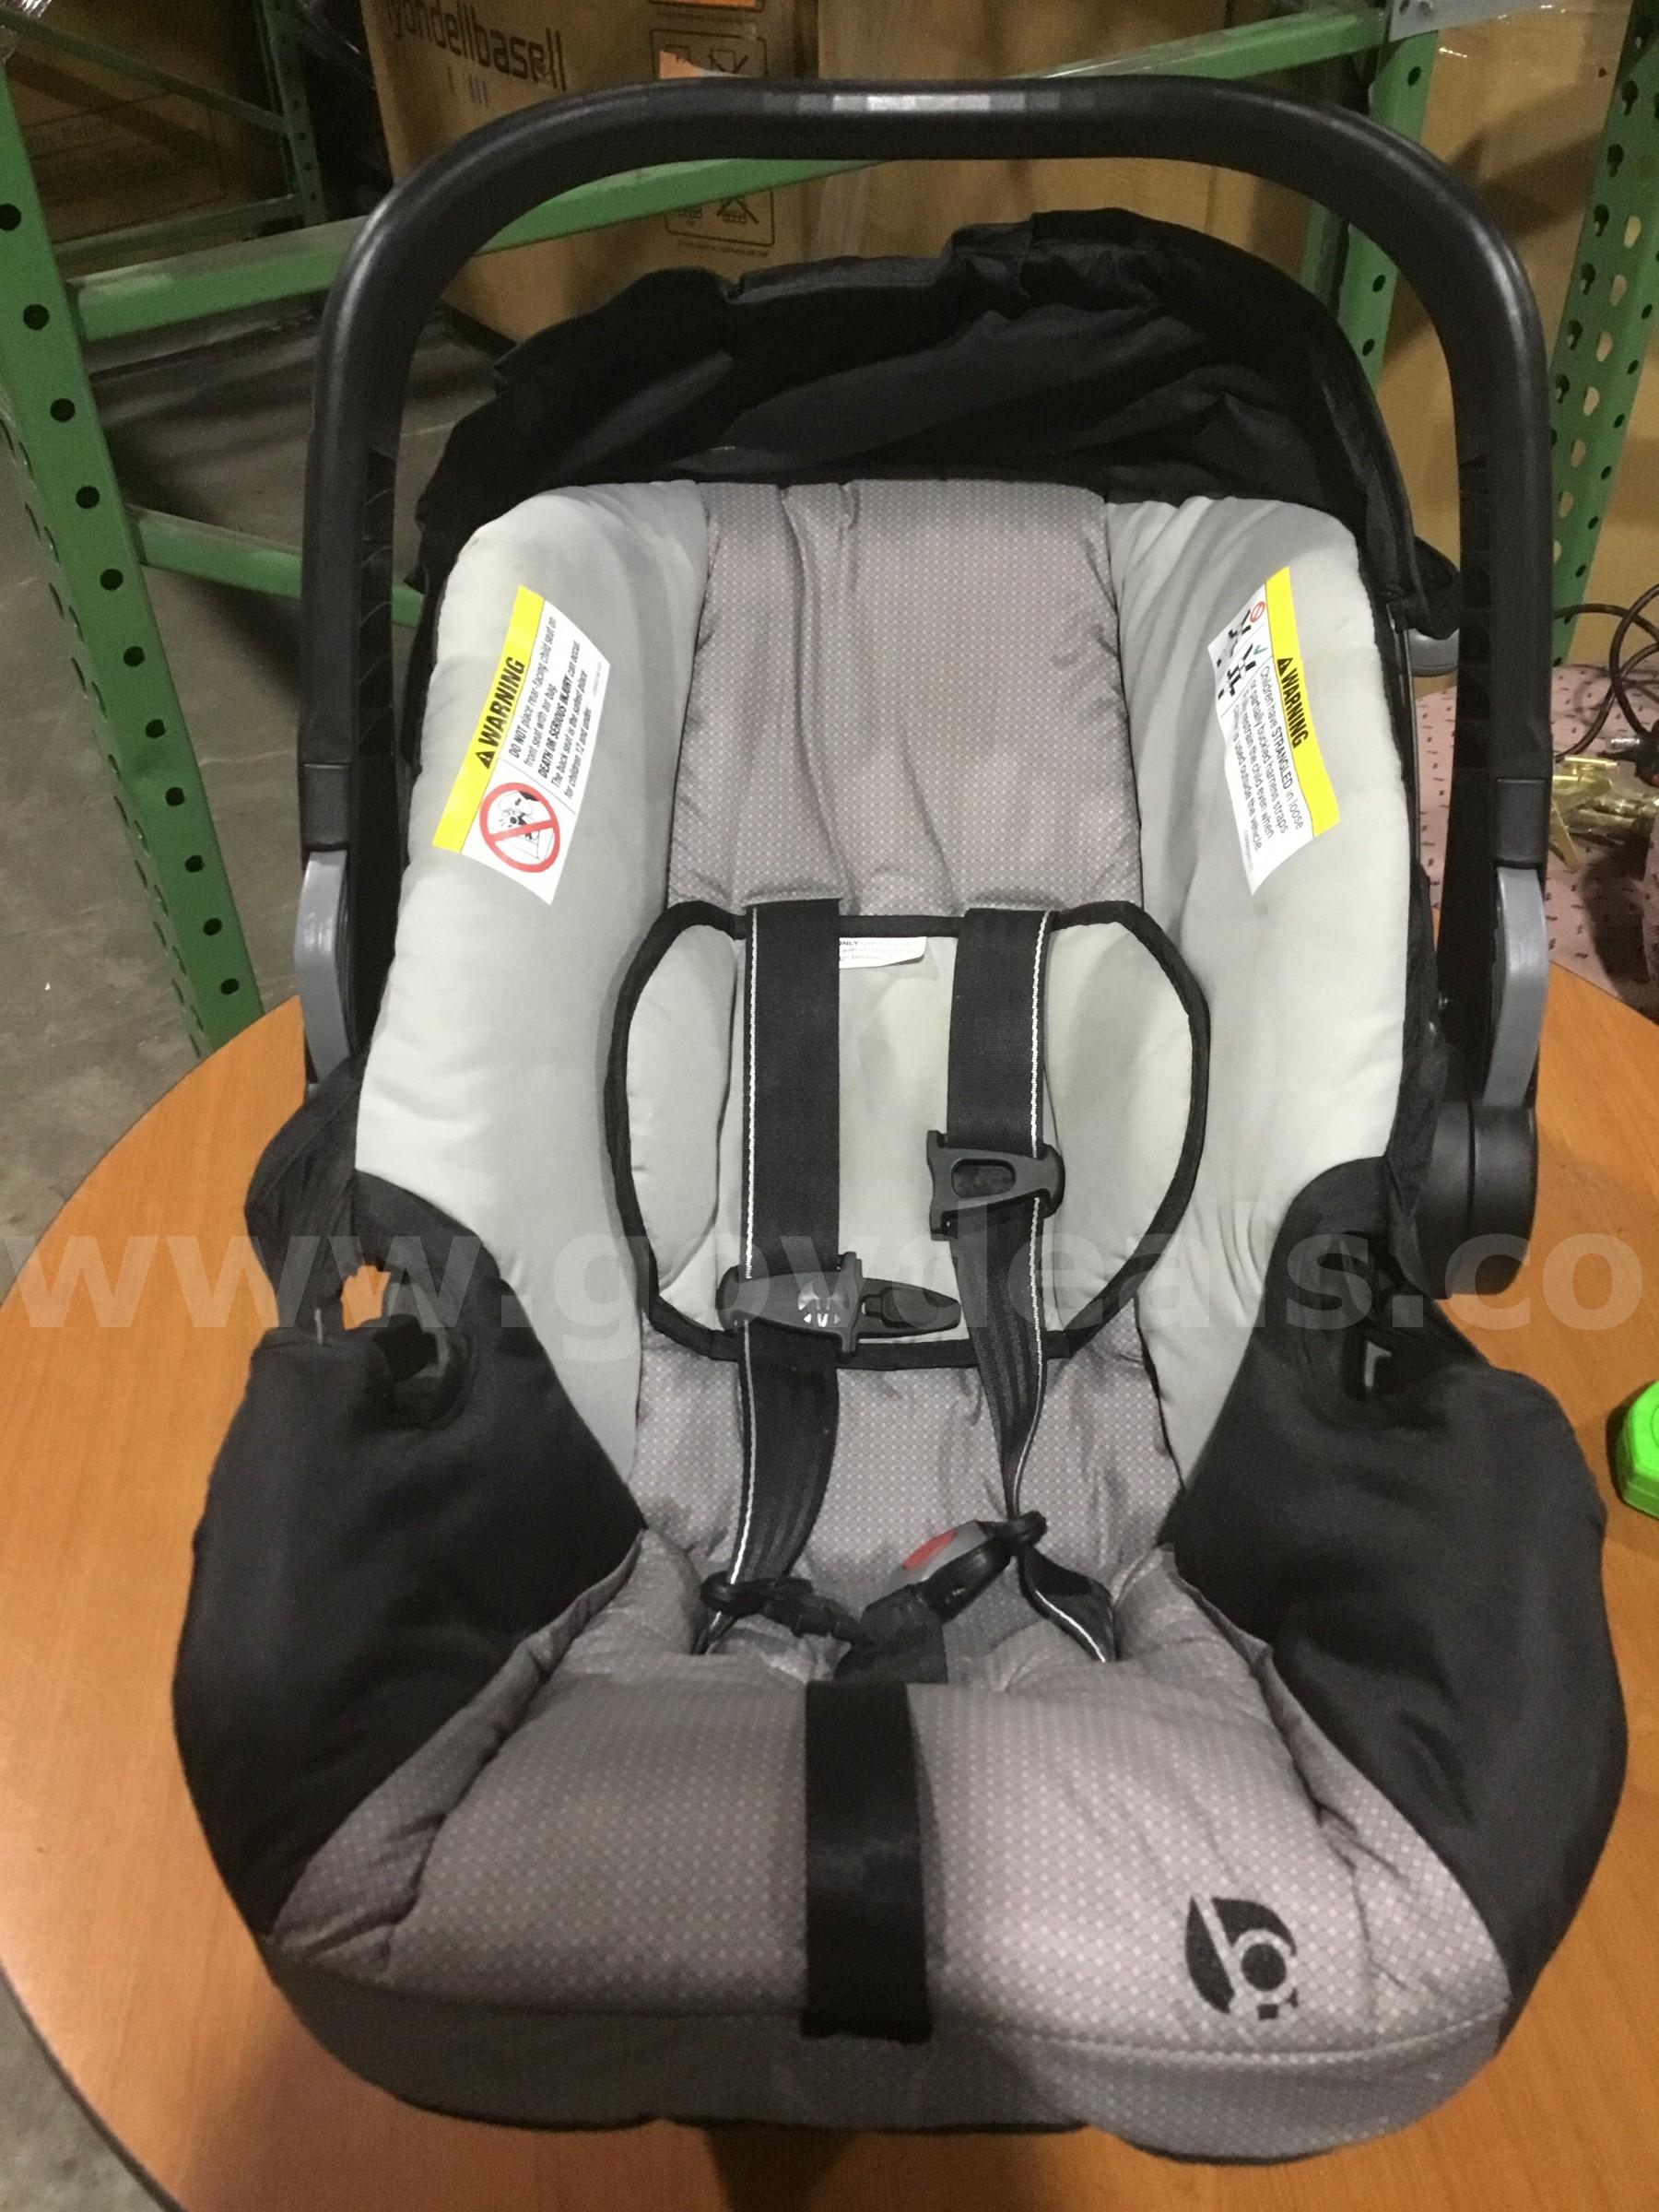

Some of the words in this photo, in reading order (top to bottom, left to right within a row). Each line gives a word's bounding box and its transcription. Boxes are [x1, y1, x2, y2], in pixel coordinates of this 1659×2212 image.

[545, 626, 554, 645] seat
[539, 641, 551, 664] child
[559, 675, 571, 705] INJURY
[1261, 666, 1274, 706] Children
[478, 656, 524, 747] WARNING
[1281, 668, 1309, 748] WARNING
[521, 705, 533, 729] place
[536, 712, 547, 730] with
[549, 703, 566, 739] SERIOUS
[569, 713, 577, 728] the
[1268, 705, 1277, 729] have
[513, 724, 527, 745] NOT
[532, 728, 542, 747] seat
[580, 727, 588, 745] and
[1242, 712, 1253, 748] restrain
[509, 743, 522, 759] DO
[546, 737, 557, 751] OR
[564, 734, 572, 754] seat
[575, 743, 584, 755] 12
[1235, 741, 1246, 765] used
[524, 746, 538, 767] front
[538, 749, 553, 778] DEATH
[556, 754, 568, 773] back
[1257, 724, 1272, 764] buckled
[1265, 761, 1278, 802] harness
[1272, 726, 1292, 789] STRANGLED
[551, 772, 563, 787] The
[568, 755, 581, 787] children
[1253, 764, 1264, 787] child
[564, 785, 573, 799] for
[1257, 788, 1266, 811] even
[1286, 792, 1294, 801] in
[1262, 813, 1274, 839] when
[1288, 799, 1303, 830] loose
